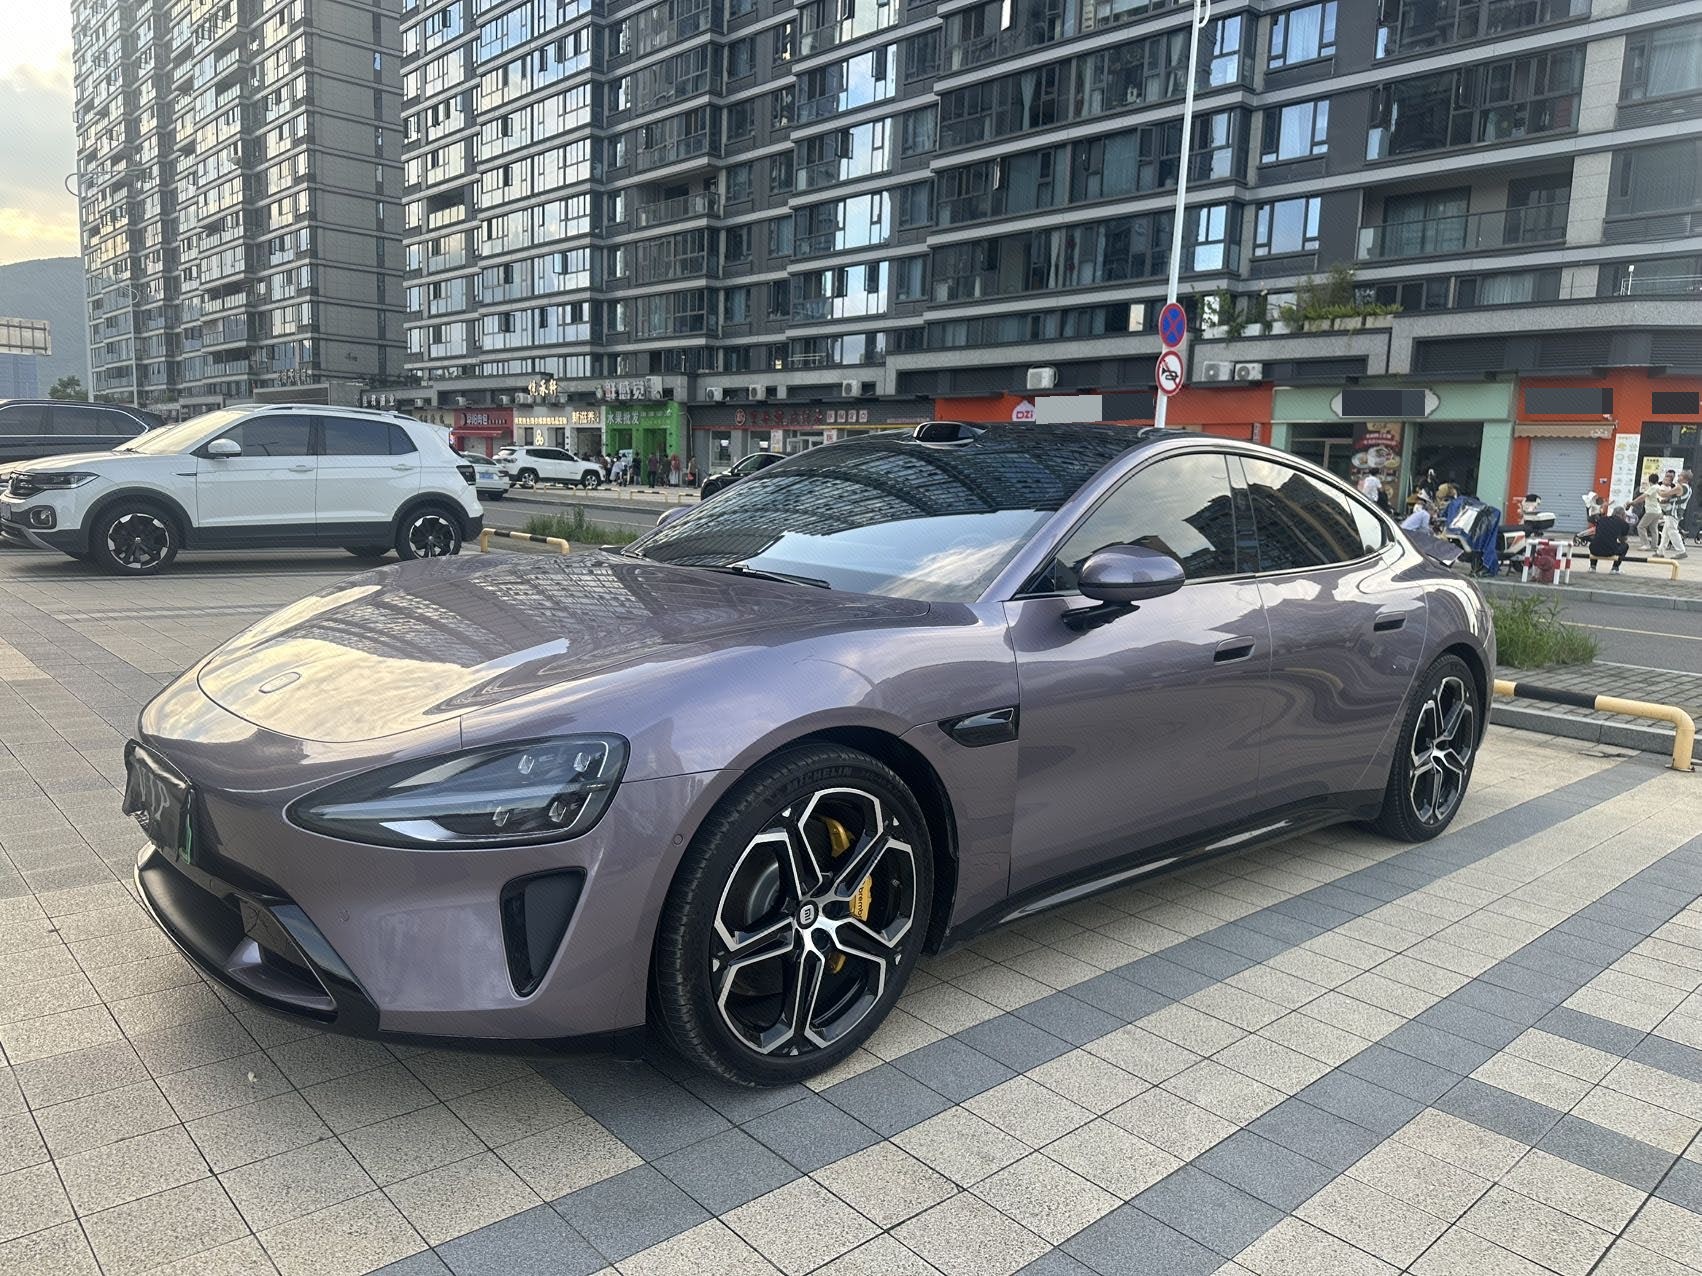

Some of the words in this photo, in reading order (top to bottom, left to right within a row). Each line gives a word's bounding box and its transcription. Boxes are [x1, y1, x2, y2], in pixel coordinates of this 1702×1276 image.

[603, 380, 645, 400] 鲜感觉
[607, 411, 640, 425] 水果批发
[786, 766, 853, 793] MICHELIN
